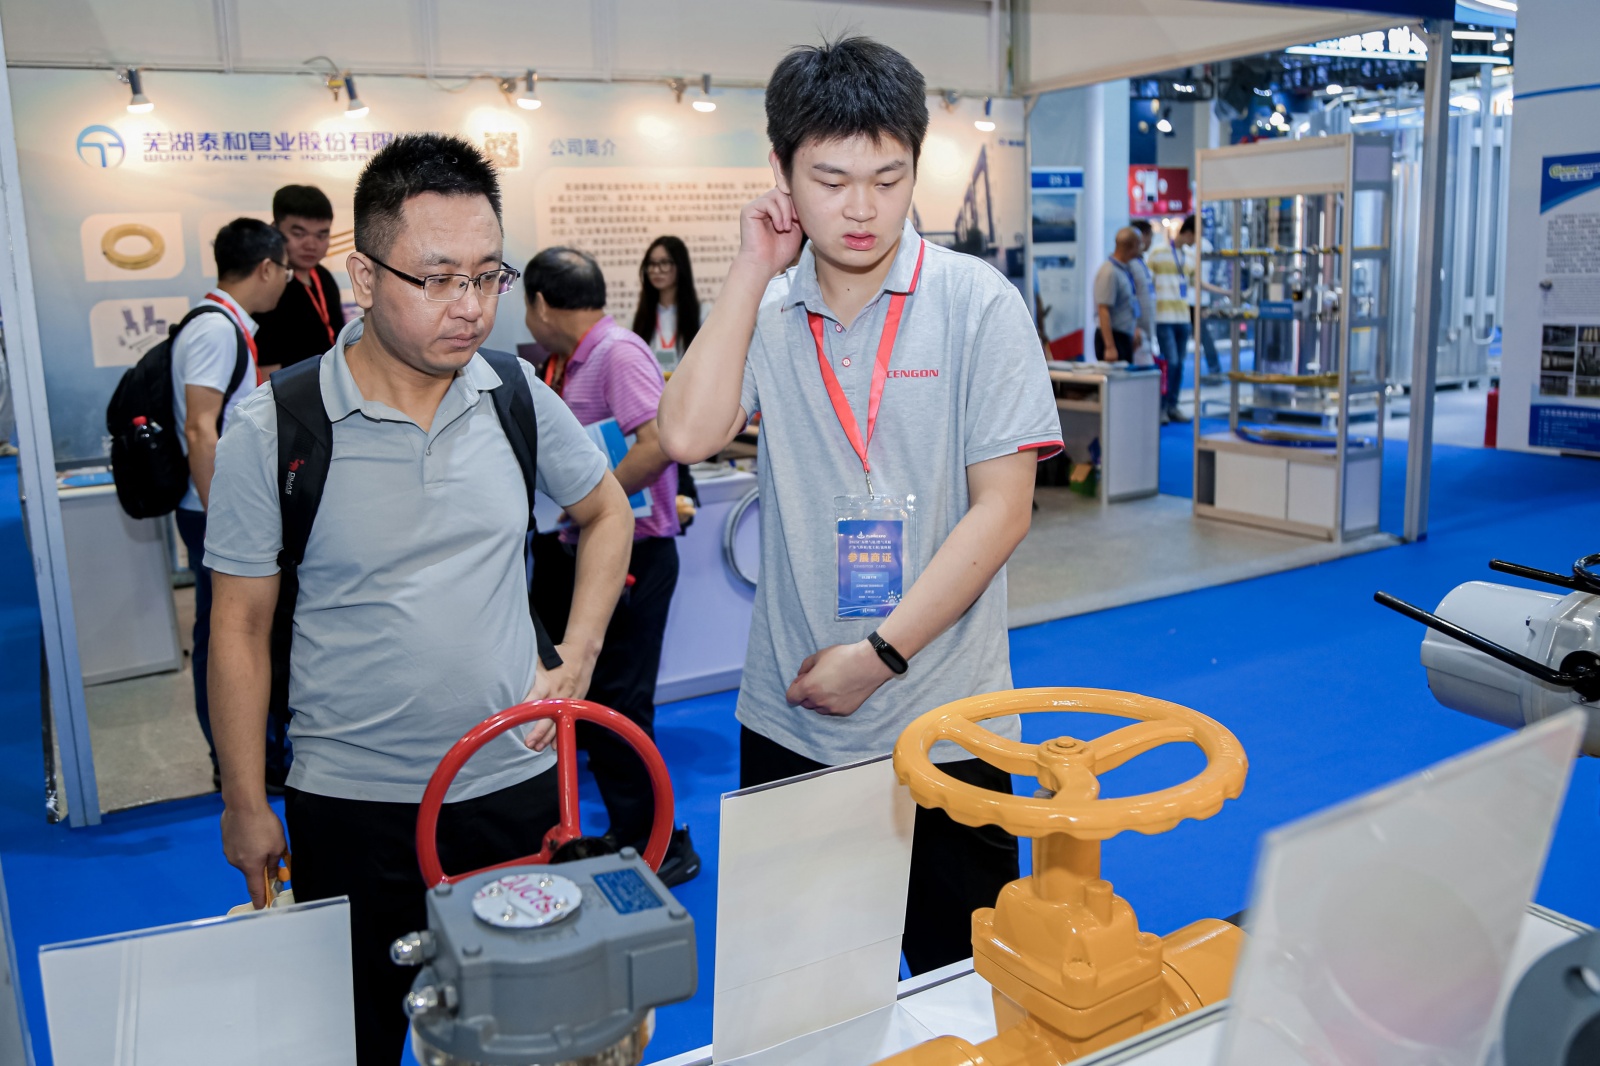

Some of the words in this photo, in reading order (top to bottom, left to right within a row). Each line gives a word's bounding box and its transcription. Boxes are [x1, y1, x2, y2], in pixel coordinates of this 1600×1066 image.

[550, 138, 616, 156] 公司简介
[144, 154, 193, 162] WUHU
[257, 153, 292, 161] PIPE
[300, 153, 371, 161] INDUSTR
[848, 552, 892, 563] 参展商证
